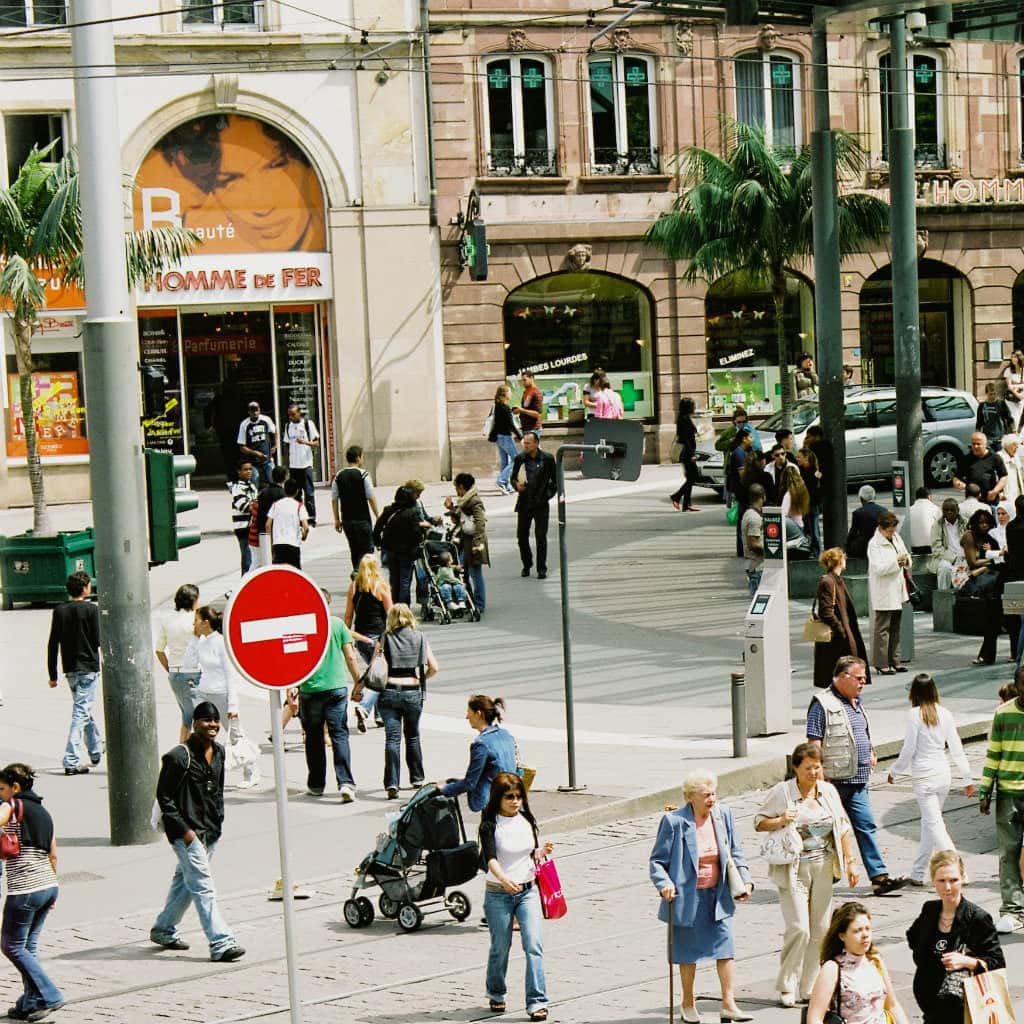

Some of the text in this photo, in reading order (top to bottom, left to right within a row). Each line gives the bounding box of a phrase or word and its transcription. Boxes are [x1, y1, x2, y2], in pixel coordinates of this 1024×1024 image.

[145, 267, 321, 293] HOMME DE FER
[550, 352, 588, 369] LOURDES
